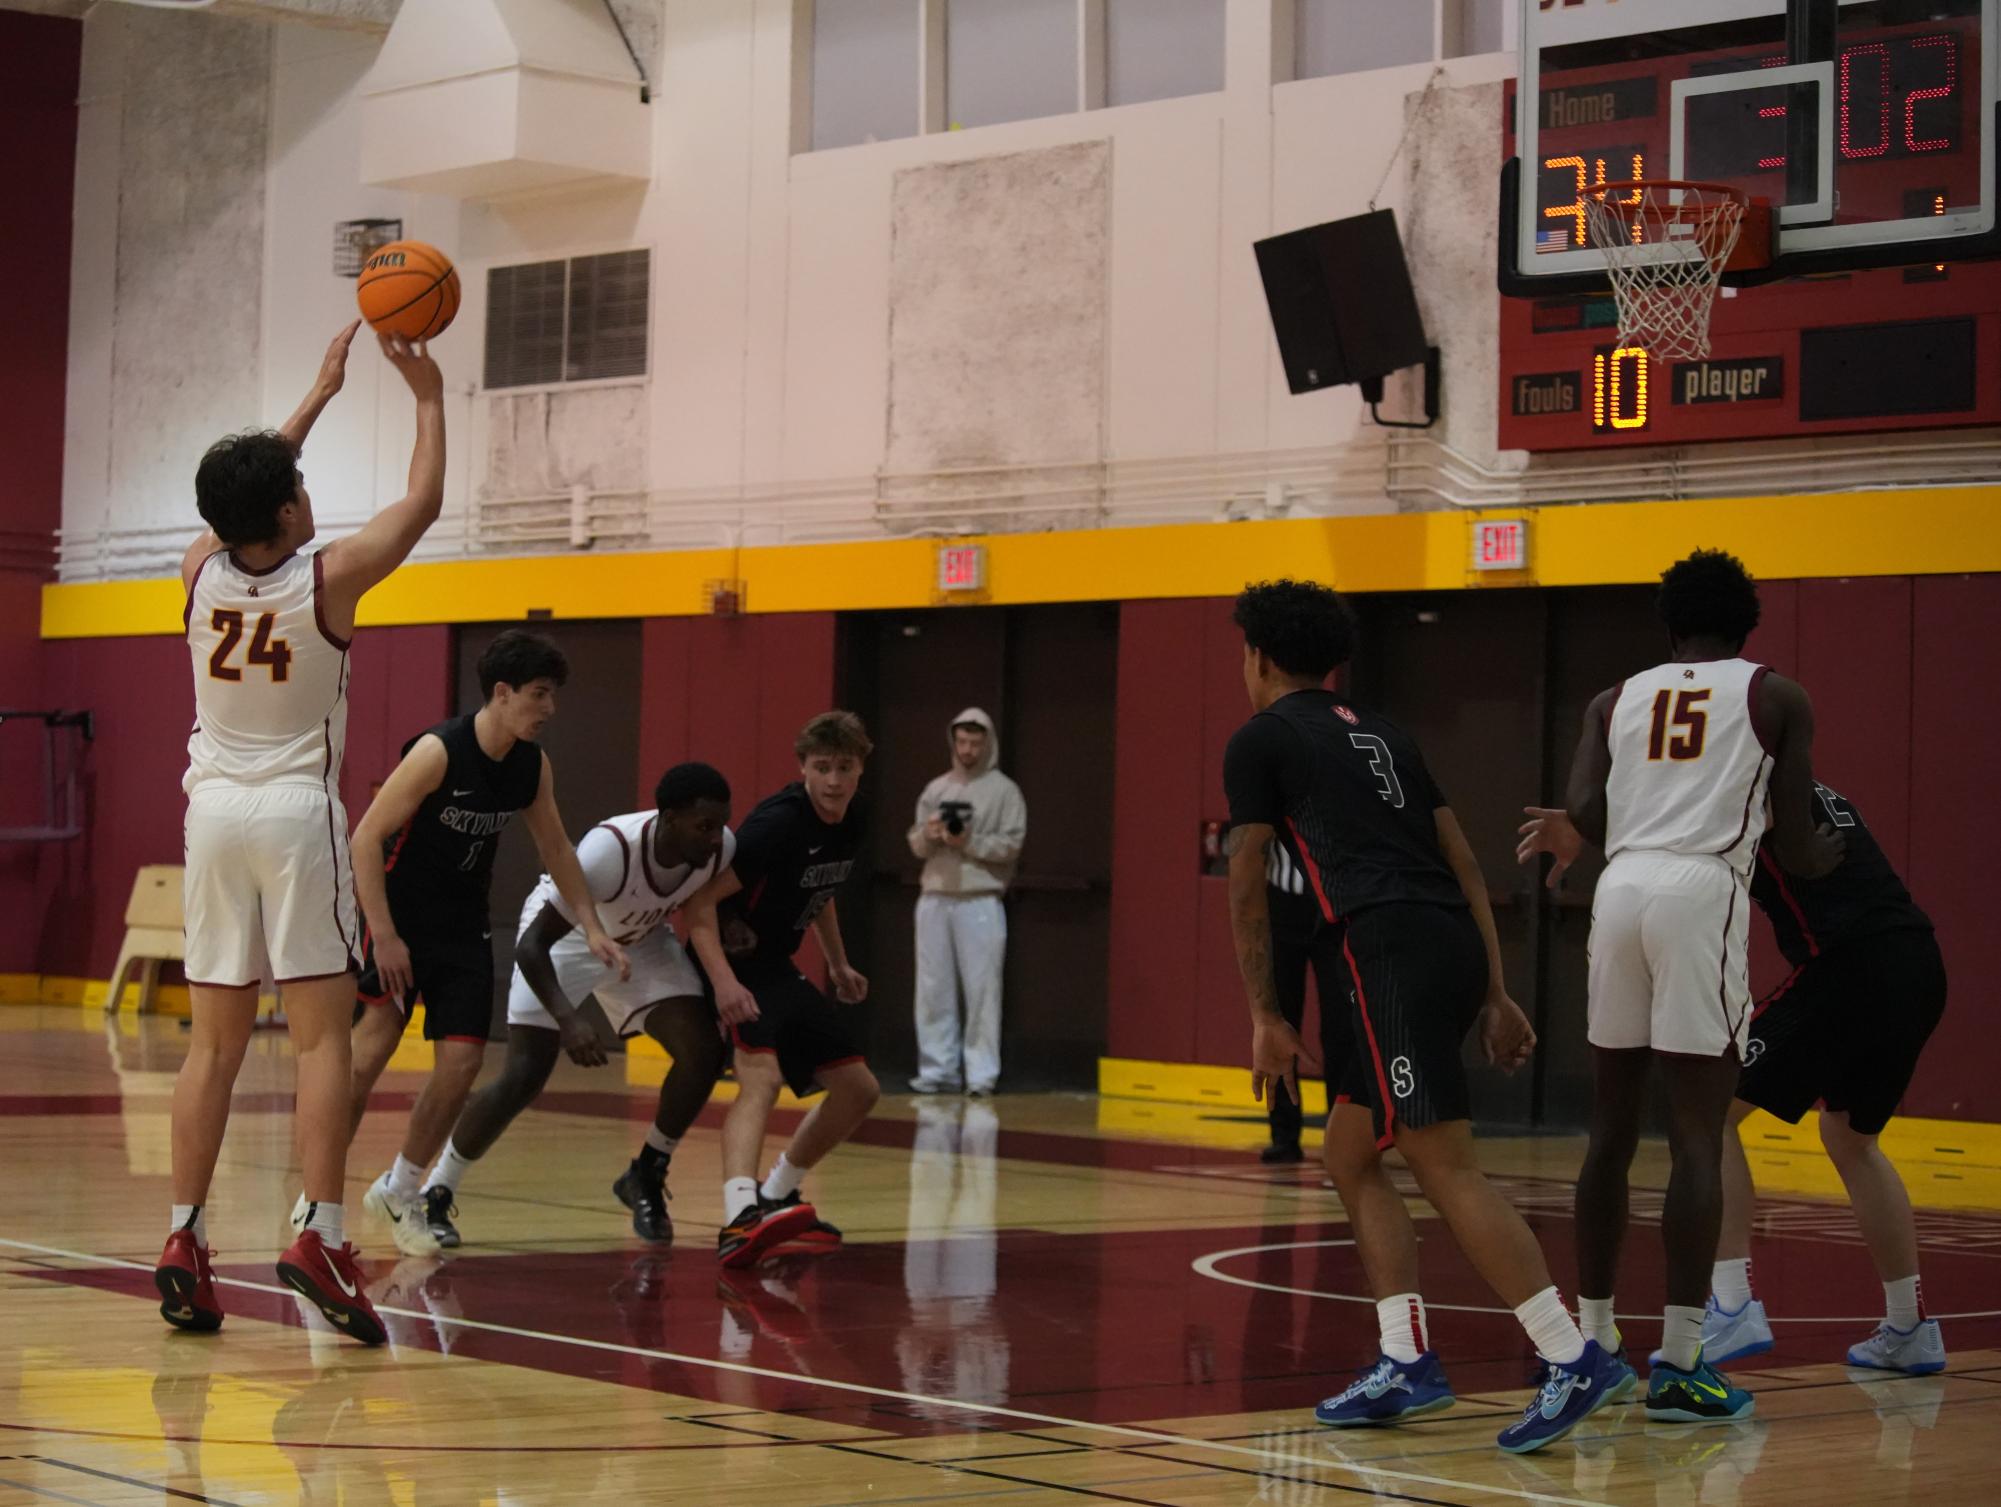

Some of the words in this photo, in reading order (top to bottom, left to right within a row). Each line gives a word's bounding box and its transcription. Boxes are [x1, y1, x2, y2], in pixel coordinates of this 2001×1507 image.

[1549, 91, 1616, 128] Home
[1544, 154, 1643, 246] 34
[1518, 378, 1575, 414] fouls
[1593, 347, 1648, 429] 10
[1684, 363, 1768, 405] player
[1483, 525, 1518, 561] EXIT
[946, 548, 976, 585] EXIT
[208, 607, 293, 683] 24
[1647, 688, 1712, 762] 15
[1347, 732, 1405, 809] 3
[1390, 1055, 1415, 1098] S
